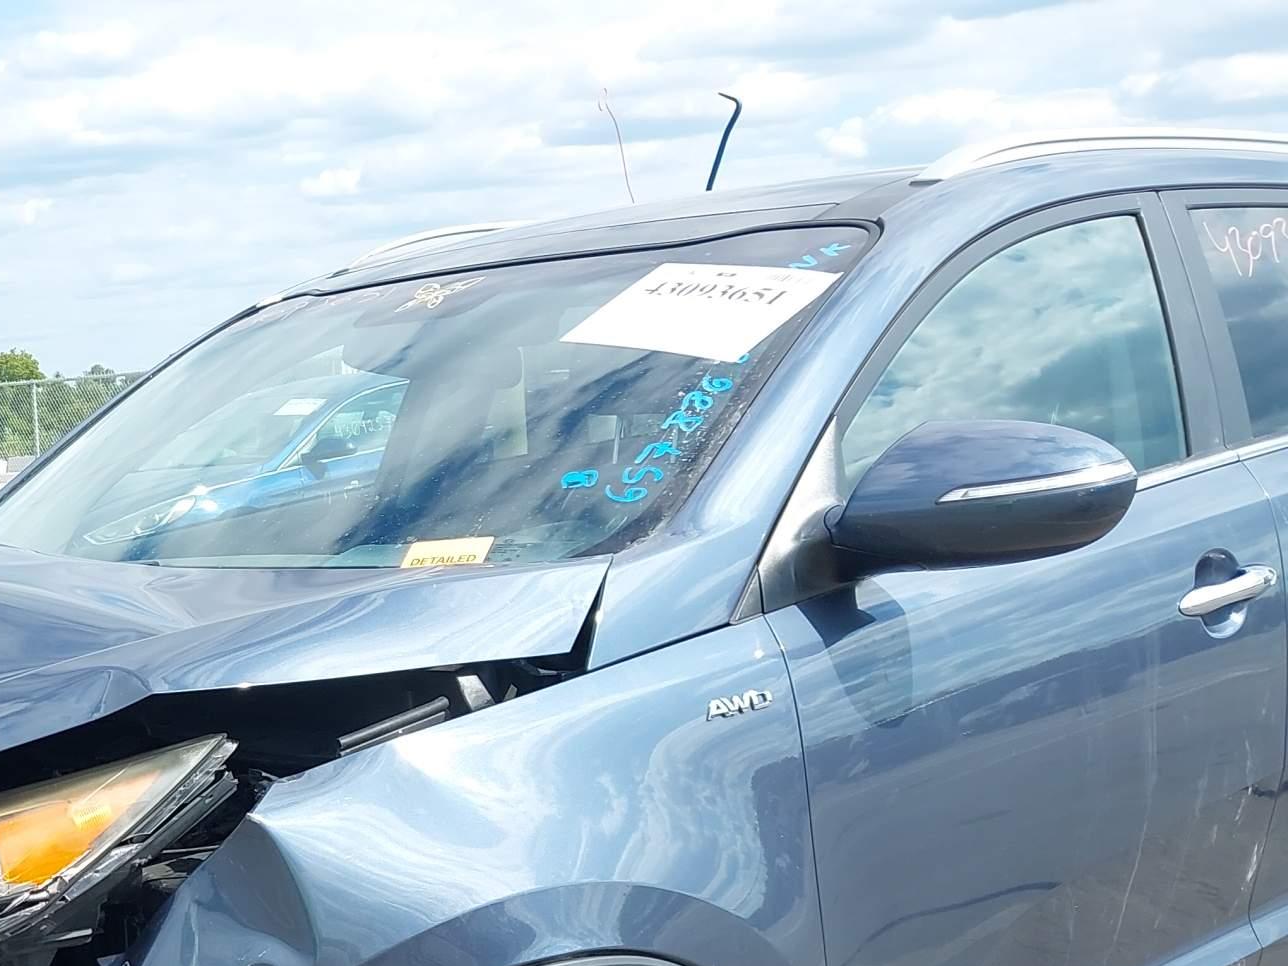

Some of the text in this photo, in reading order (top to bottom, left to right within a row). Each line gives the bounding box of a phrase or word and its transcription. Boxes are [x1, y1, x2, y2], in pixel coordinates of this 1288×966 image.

[645, 280, 788, 304] 43093651
[410, 554, 477, 567] DETAILED
[706, 690, 773, 721] AWD
